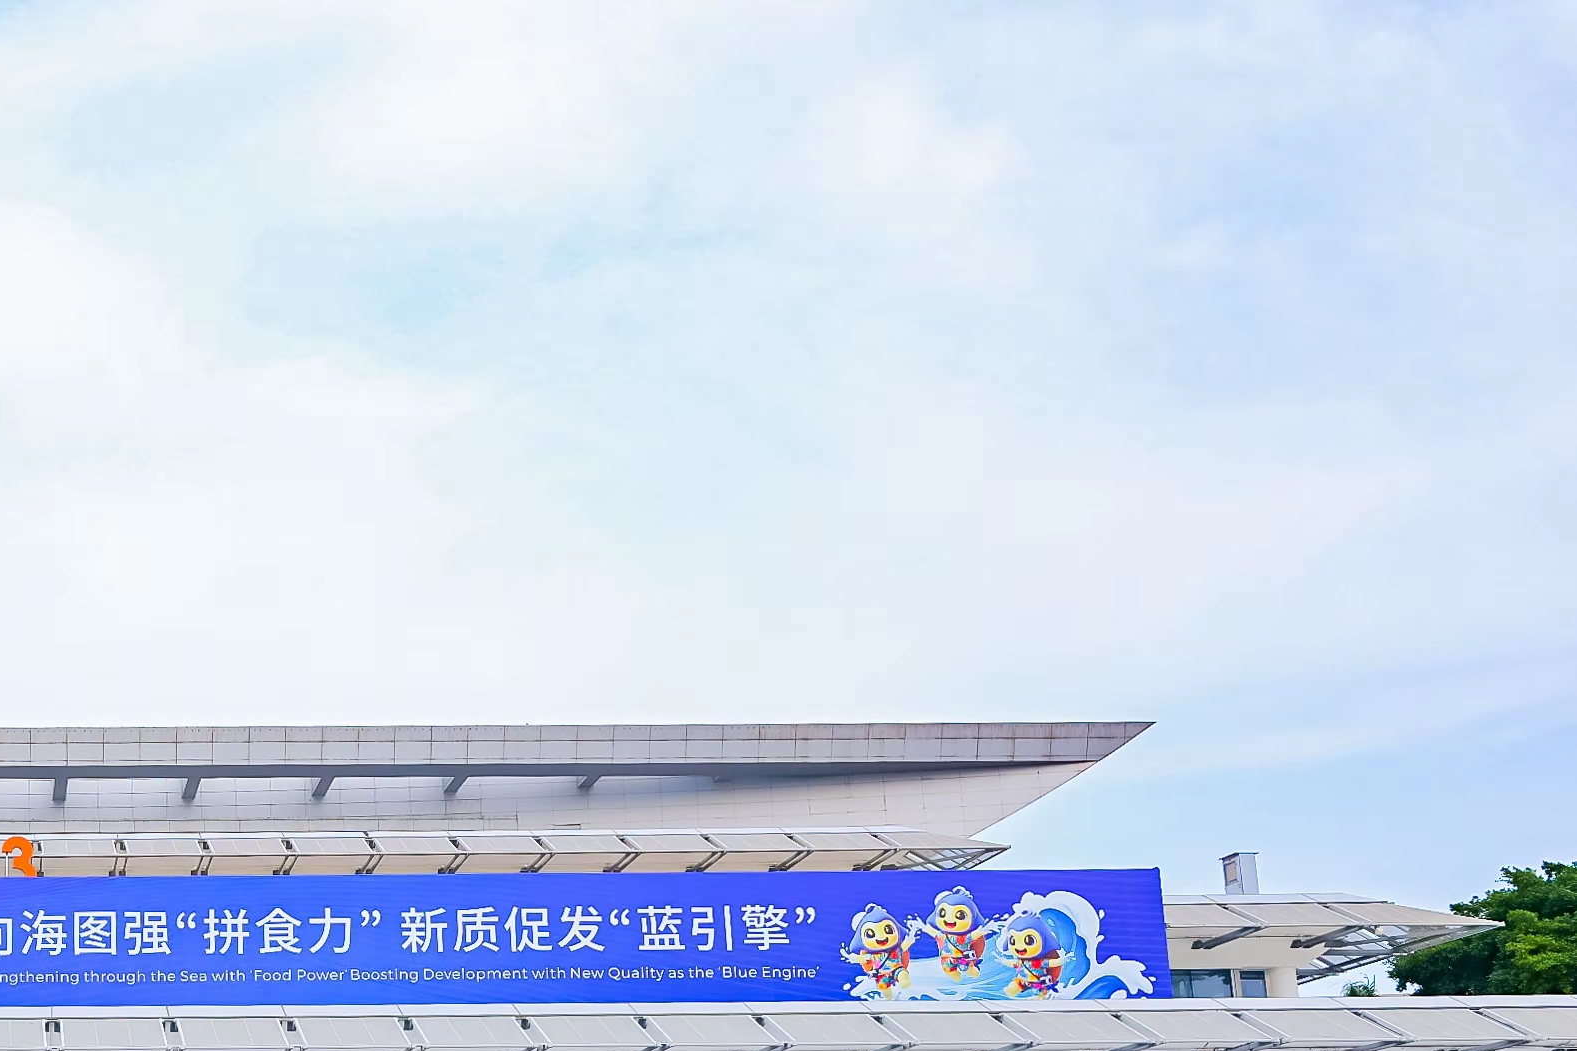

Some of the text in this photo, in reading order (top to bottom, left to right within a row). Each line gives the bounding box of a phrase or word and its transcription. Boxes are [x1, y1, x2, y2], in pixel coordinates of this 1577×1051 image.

[84, 971, 145, 984] through
[151, 970, 175, 981] the
[181, 971, 207, 981] Sea
[212, 970, 245, 981] with
[351, 969, 418, 983] Boosting
[424, 968, 528, 982] Development
[532, 967, 565, 979] with
[571, 968, 604, 978] New
[609, 967, 664, 982] Quality
[669, 970, 684, 978] as
[689, 967, 714, 978] the
